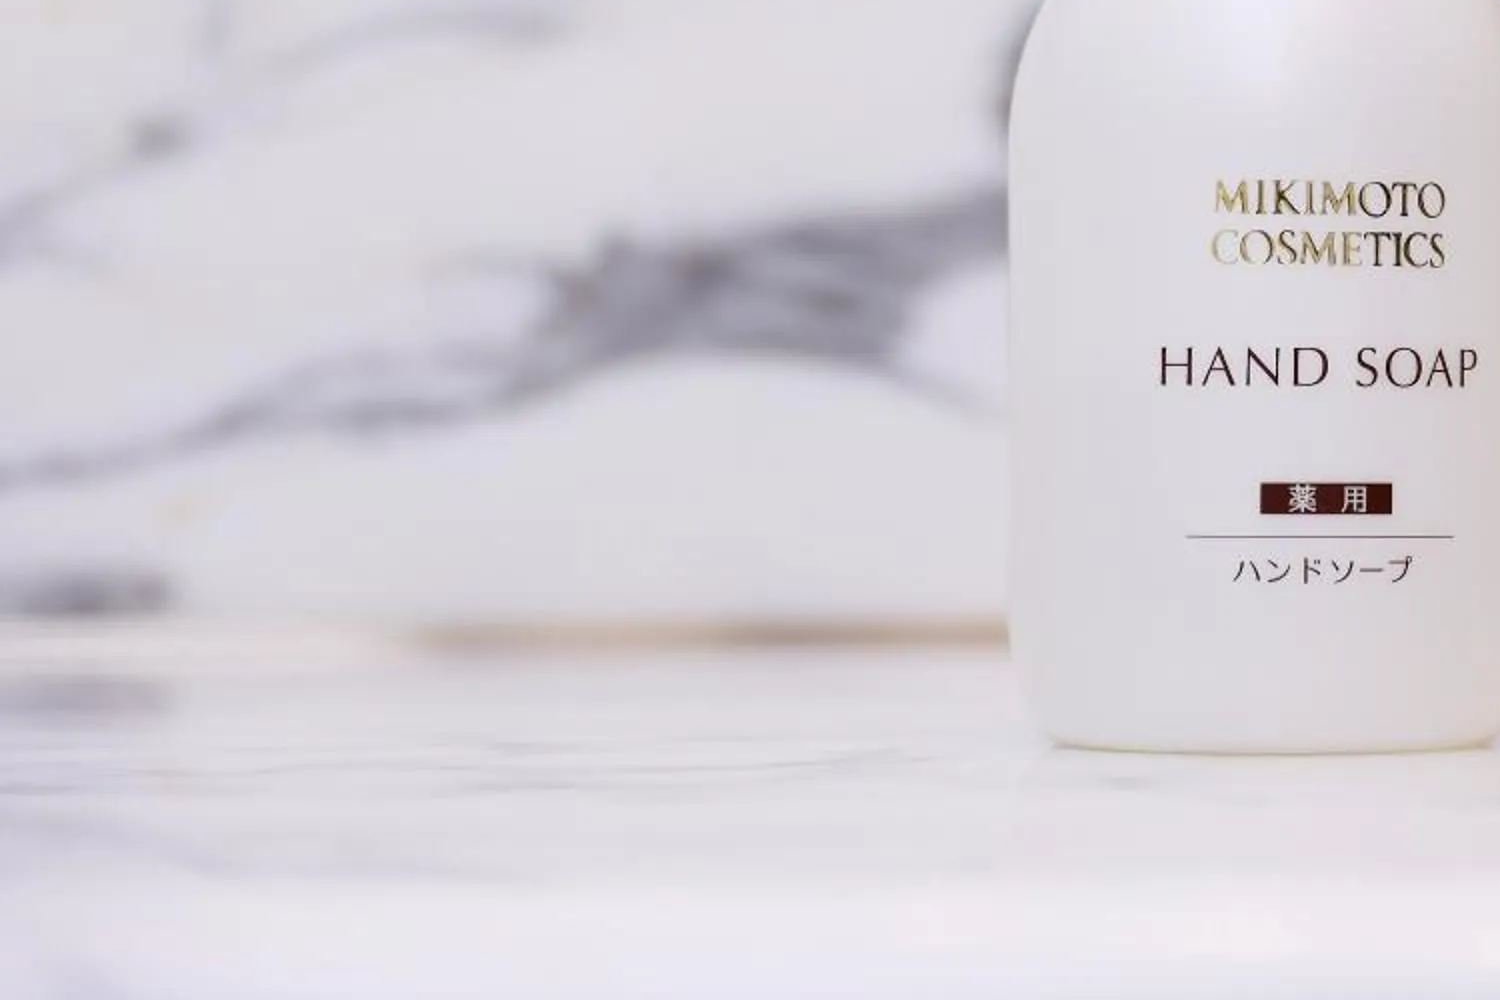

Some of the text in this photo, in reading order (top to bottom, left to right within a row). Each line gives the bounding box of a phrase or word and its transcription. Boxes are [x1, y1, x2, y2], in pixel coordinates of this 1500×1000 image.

[1213, 179, 1447, 219] MIKIMOTO
[1211, 229, 1446, 269] COSMETICS
[1160, 346, 1479, 389] HAND SOAP
[1232, 555, 1413, 585] ハンドソープ
